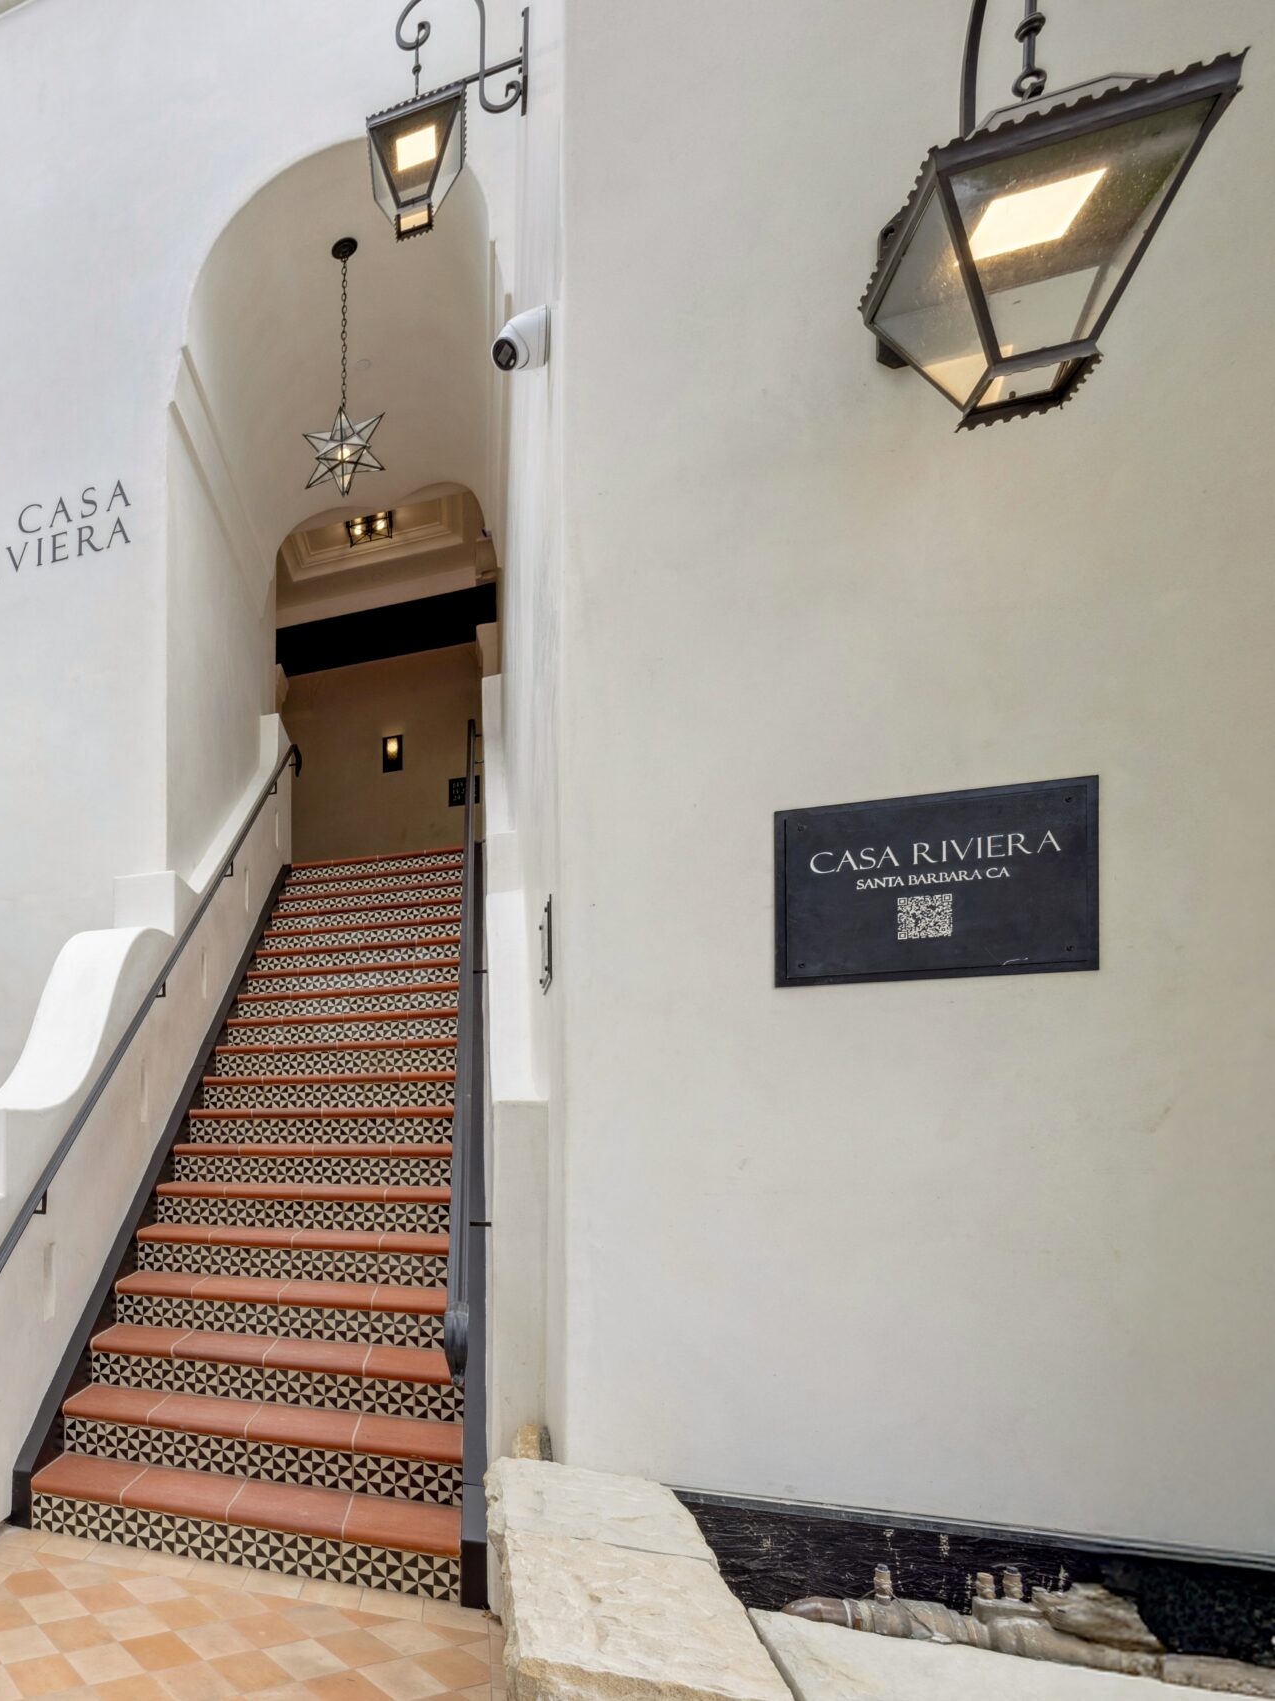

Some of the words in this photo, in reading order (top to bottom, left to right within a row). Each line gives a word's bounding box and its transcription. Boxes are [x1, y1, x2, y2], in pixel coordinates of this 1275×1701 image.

[17, 479, 132, 534] CASA
[809, 845, 900, 875] CASA
[912, 829, 1062, 866] RIVIERA
[855, 875, 905, 890] SANTA
[908, 868, 982, 886] BARBARA
[986, 866, 1010, 880] CA
